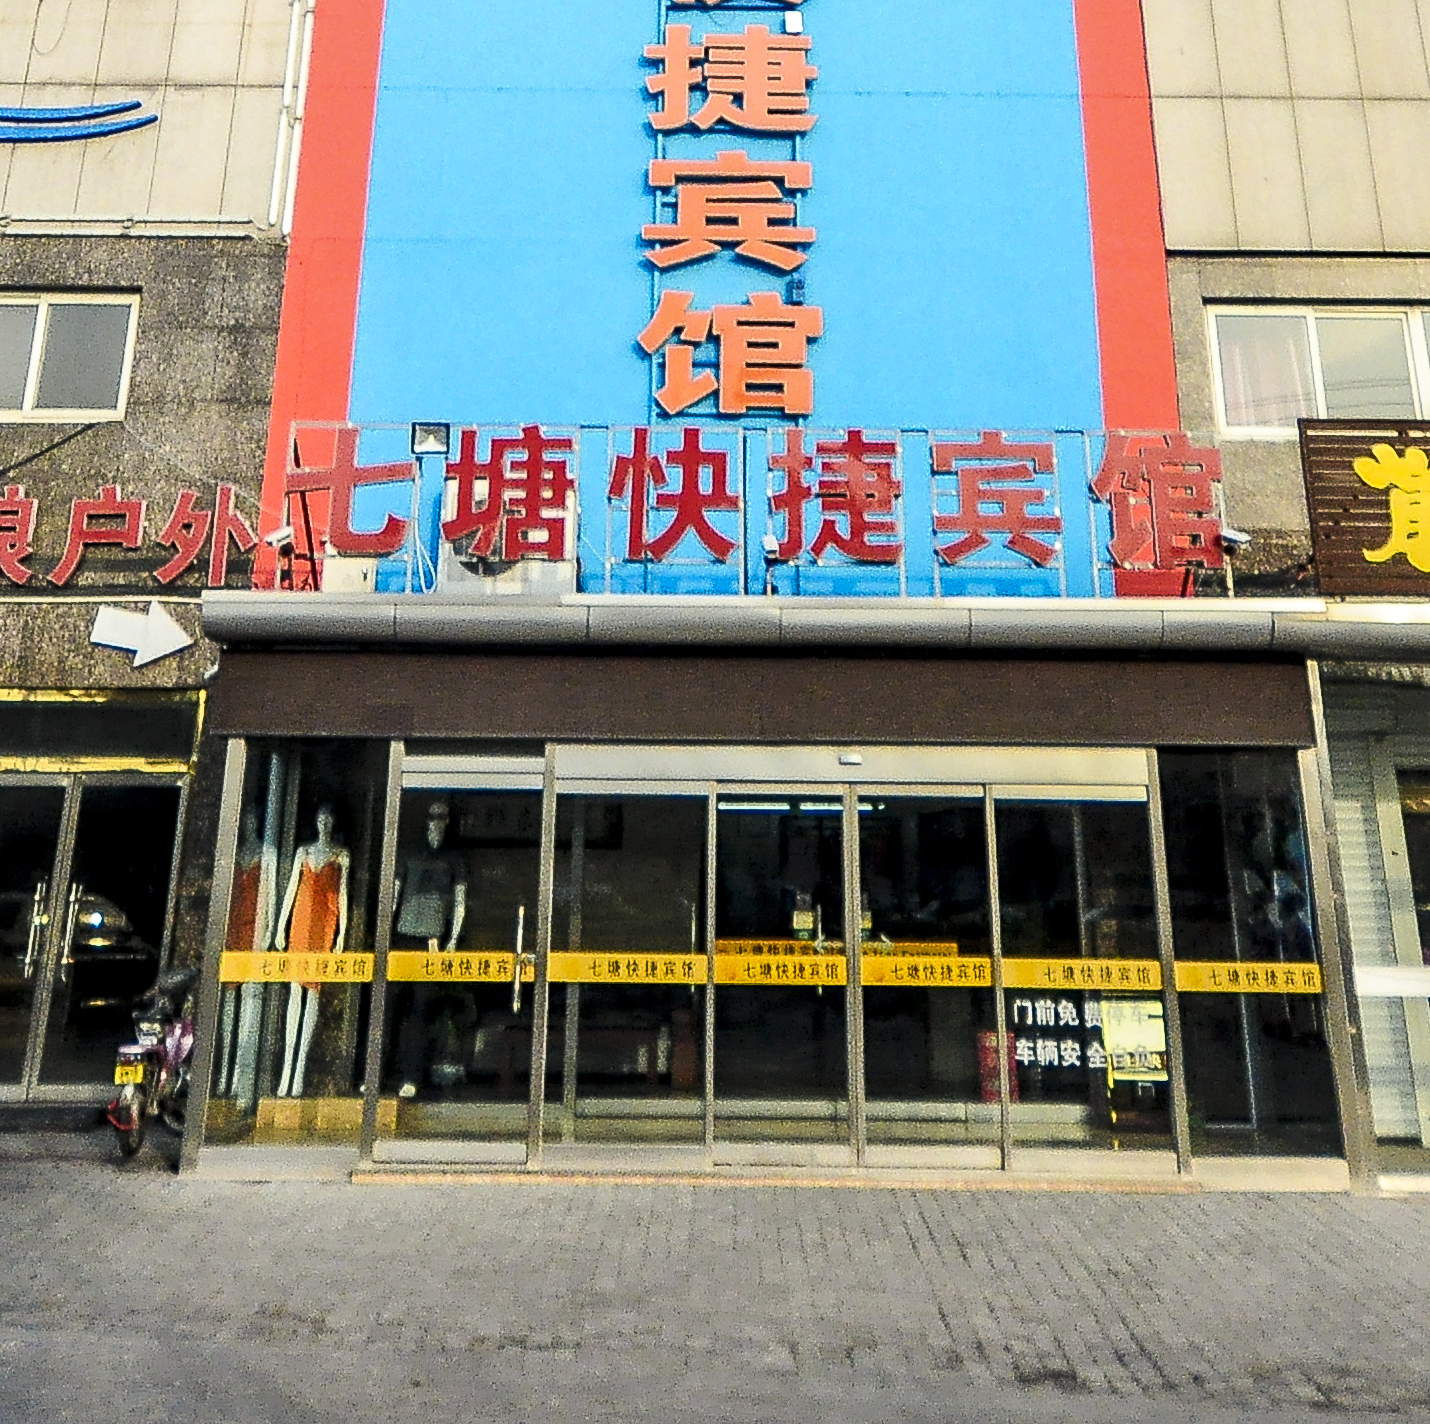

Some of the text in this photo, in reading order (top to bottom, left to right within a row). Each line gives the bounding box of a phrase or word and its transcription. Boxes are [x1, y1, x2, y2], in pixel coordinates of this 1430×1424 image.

[285, 422, 1225, 569] 七塘快捷宾馆
